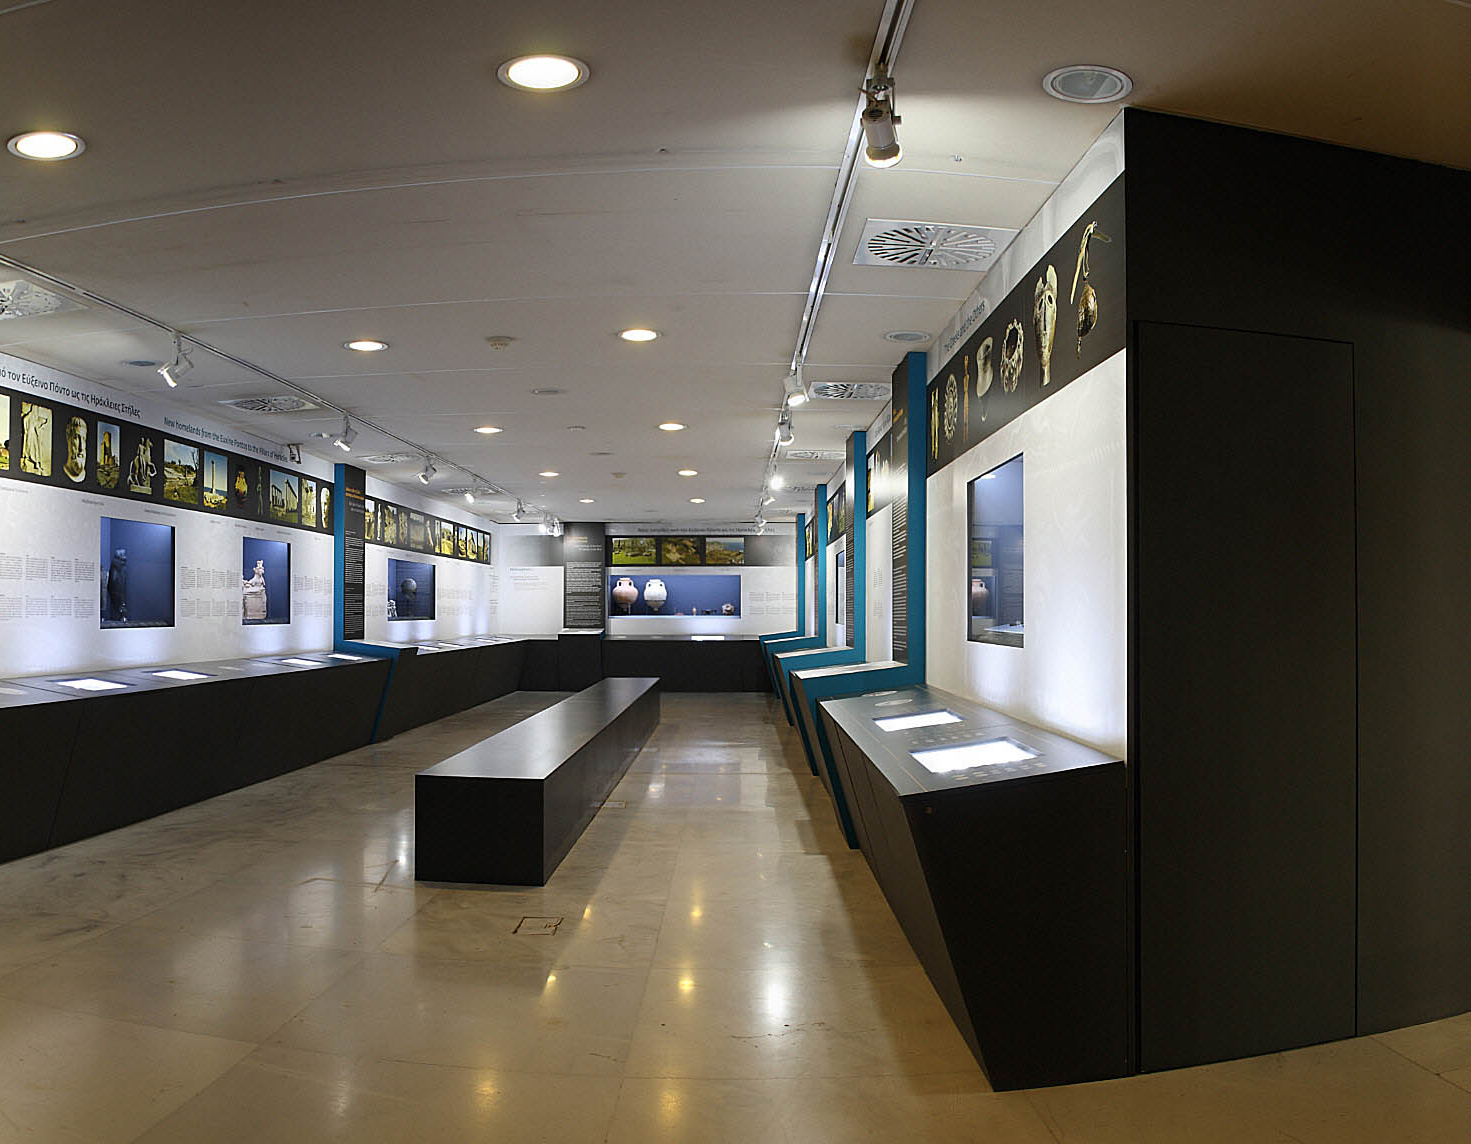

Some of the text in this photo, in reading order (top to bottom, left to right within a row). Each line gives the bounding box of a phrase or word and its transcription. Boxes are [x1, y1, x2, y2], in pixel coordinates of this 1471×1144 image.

[8, 371, 21, 382] τον
[22, 373, 48, 390] Εύξεινο
[49, 381, 71, 397] Πόντο
[71, 391, 80, 401] ως
[81, 392, 90, 404] τις
[90, 394, 121, 414] Ηράκλειες
[163, 416, 175, 428] New
[176, 420, 201, 436] homelands
